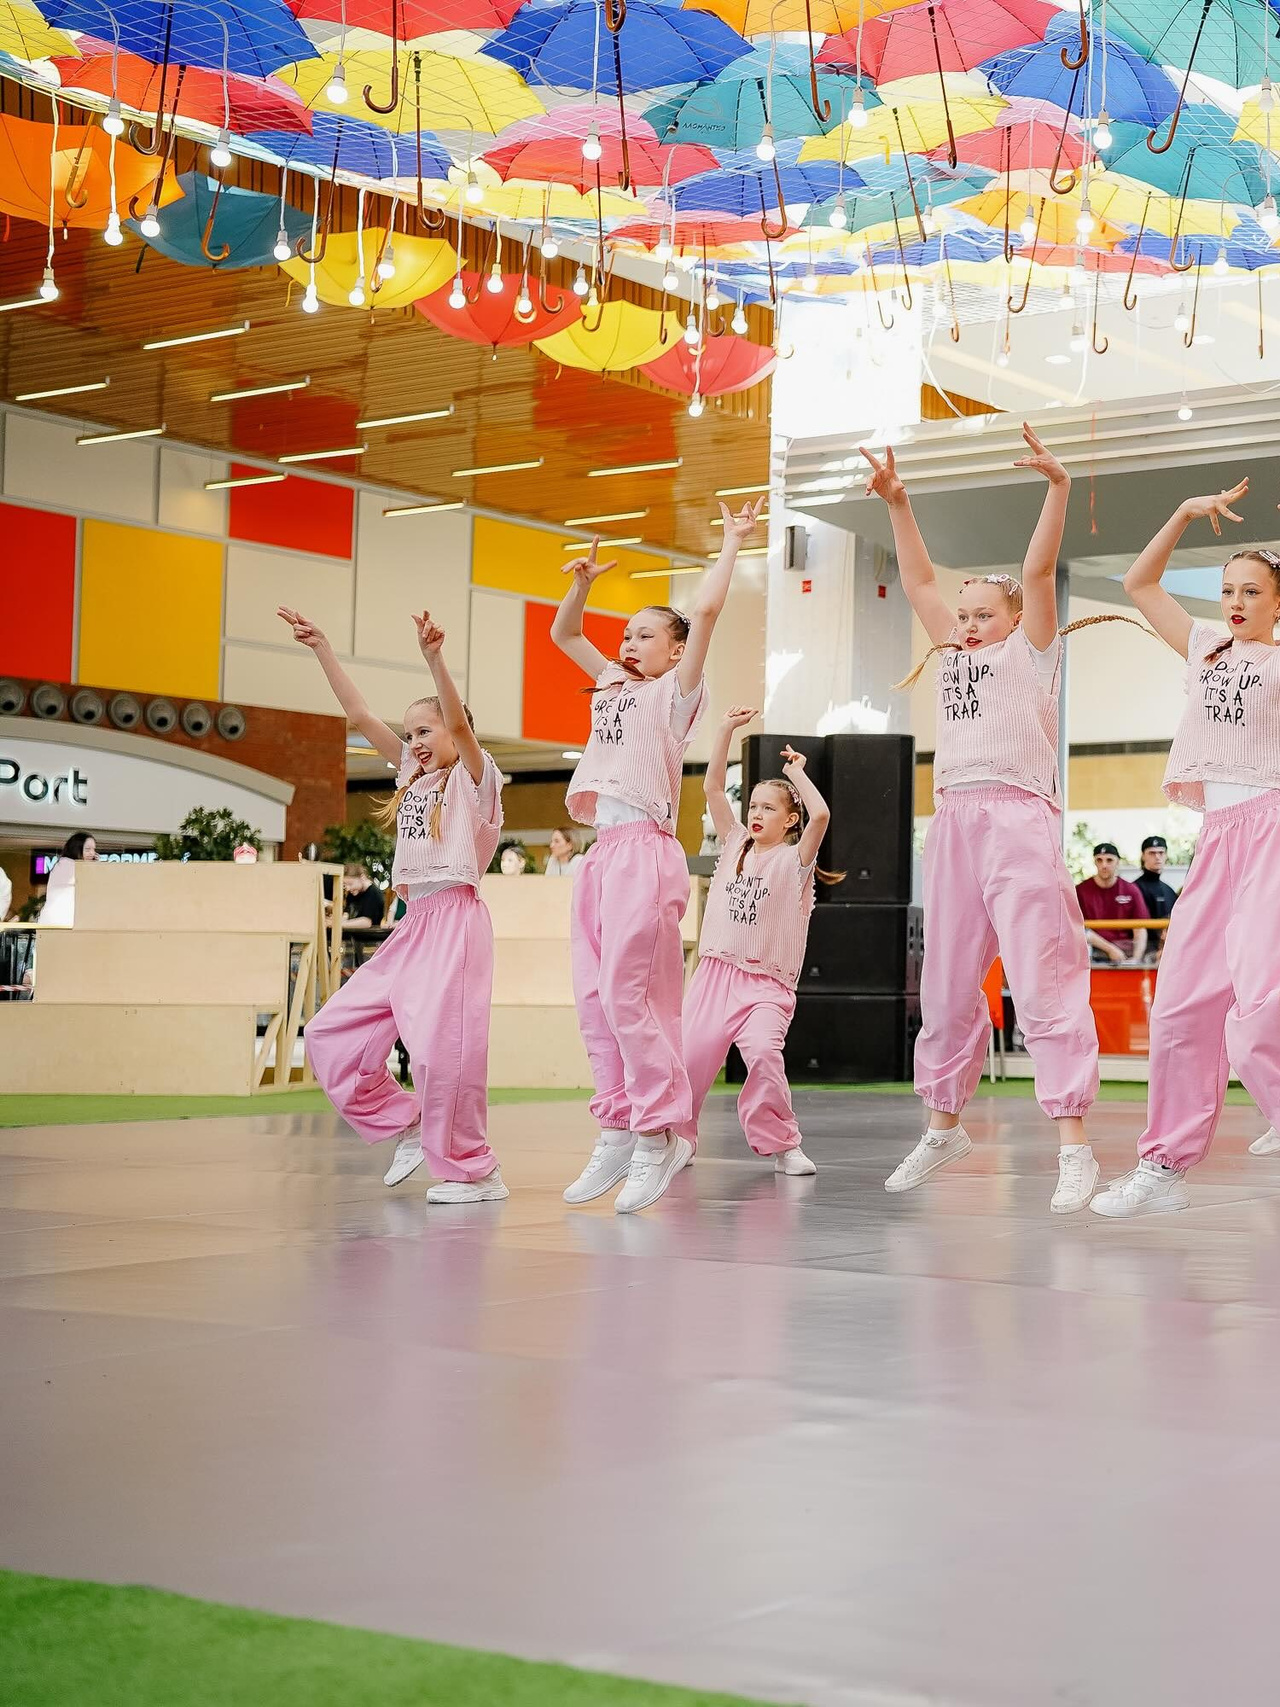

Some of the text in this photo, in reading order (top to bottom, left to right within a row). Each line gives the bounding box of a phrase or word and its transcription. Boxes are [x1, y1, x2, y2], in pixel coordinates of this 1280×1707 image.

[968, 664, 994, 683] UP.
[1239, 675, 1263, 690] UP.
[943, 682, 977, 703] IT'S A
[1204, 686, 1243, 706] IT'S A
[618, 698, 638, 713] UP.
[944, 699, 982, 721] TRAP.
[613, 712, 622, 728] A
[1205, 705, 1246, 727] TRAP.
[594, 729, 625, 746] TRAP.
[397, 803, 428, 815] ROW
[400, 815, 424, 826] IT'S
[753, 887, 771, 901] UP.
[729, 895, 757, 913] IT'S A
[729, 908, 758, 926] TRAP.
